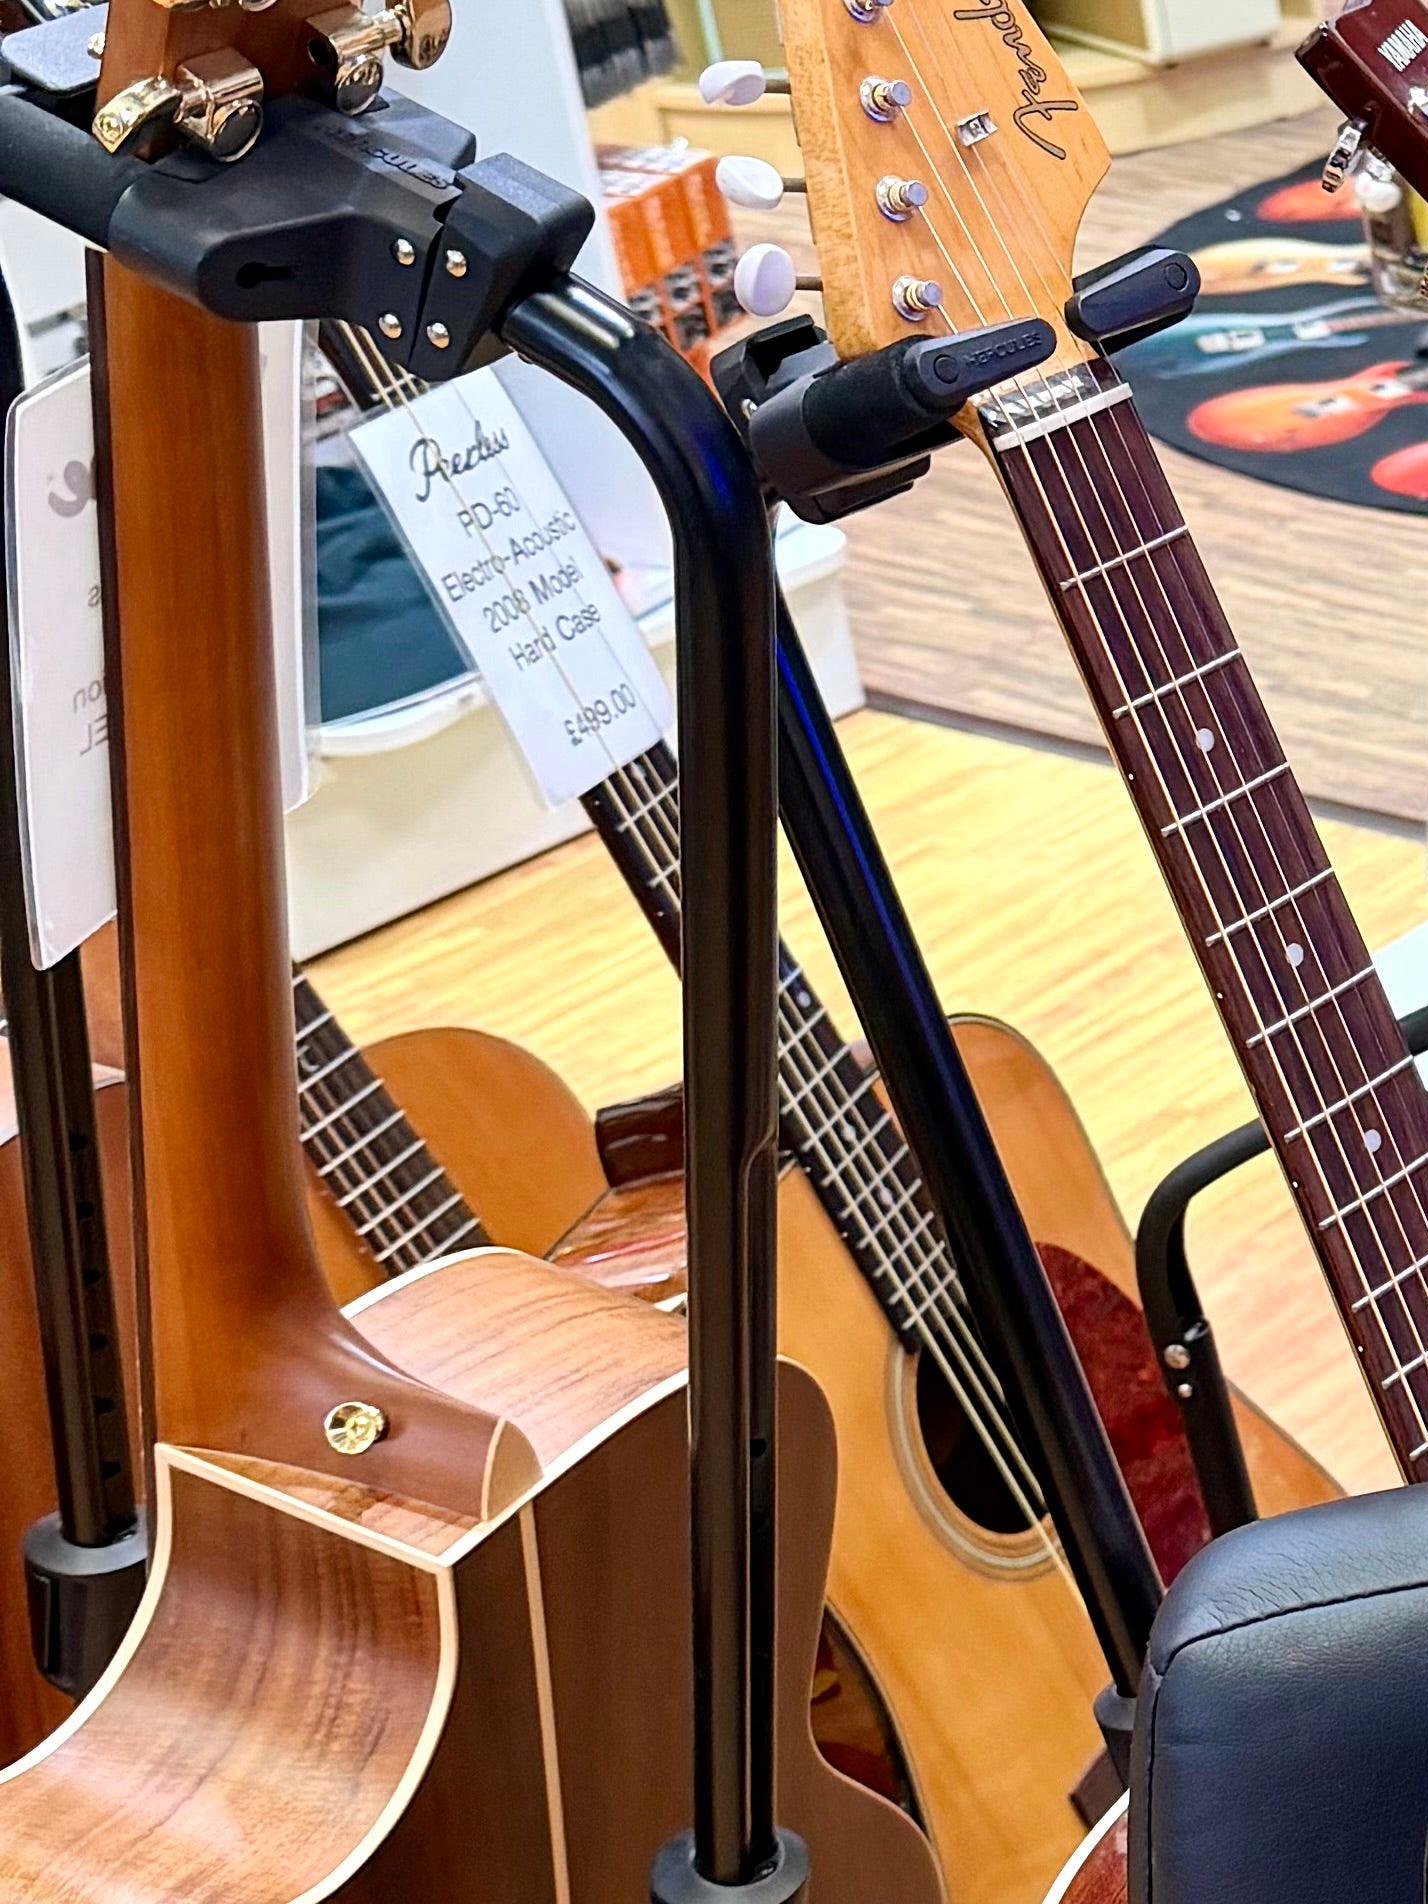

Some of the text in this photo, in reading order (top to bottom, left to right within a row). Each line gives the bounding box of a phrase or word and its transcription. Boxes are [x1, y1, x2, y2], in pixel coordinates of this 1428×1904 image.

[964, 330, 1042, 367] HERCULES
[410, 420, 509, 503] Peerless
[457, 487, 521, 538] PD-60
[441, 511, 577, 602] Electro-Acoustic
[531, 558, 584, 607] Model
[556, 603, 602, 643] Case
[563, 683, 637, 747] £499.00
